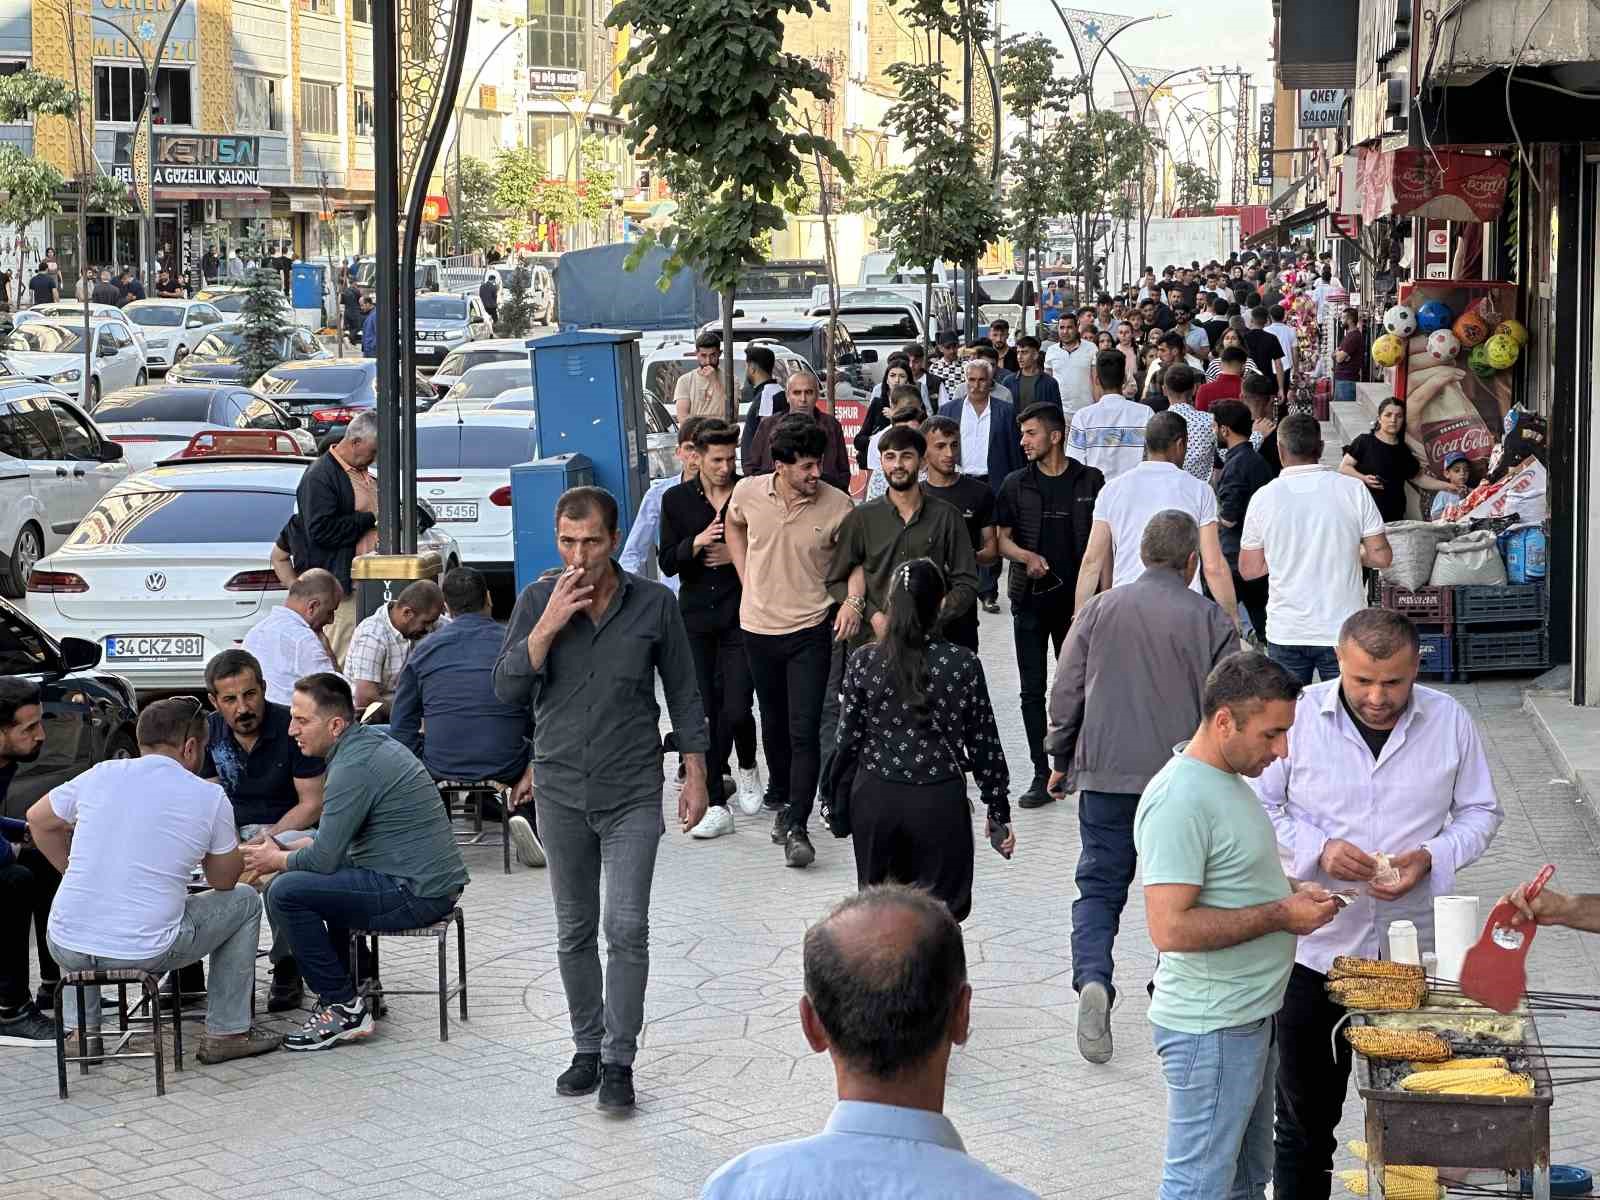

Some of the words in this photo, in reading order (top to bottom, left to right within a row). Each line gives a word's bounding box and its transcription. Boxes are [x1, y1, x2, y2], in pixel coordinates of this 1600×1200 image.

[1310, 89, 1337, 104] OKEY
[219, 170, 260, 186] SALONU
[446, 504, 476, 518] 5456
[116, 640, 135, 655] 34
[138, 639, 172, 655] CKZ
[174, 639, 200, 654] 981
